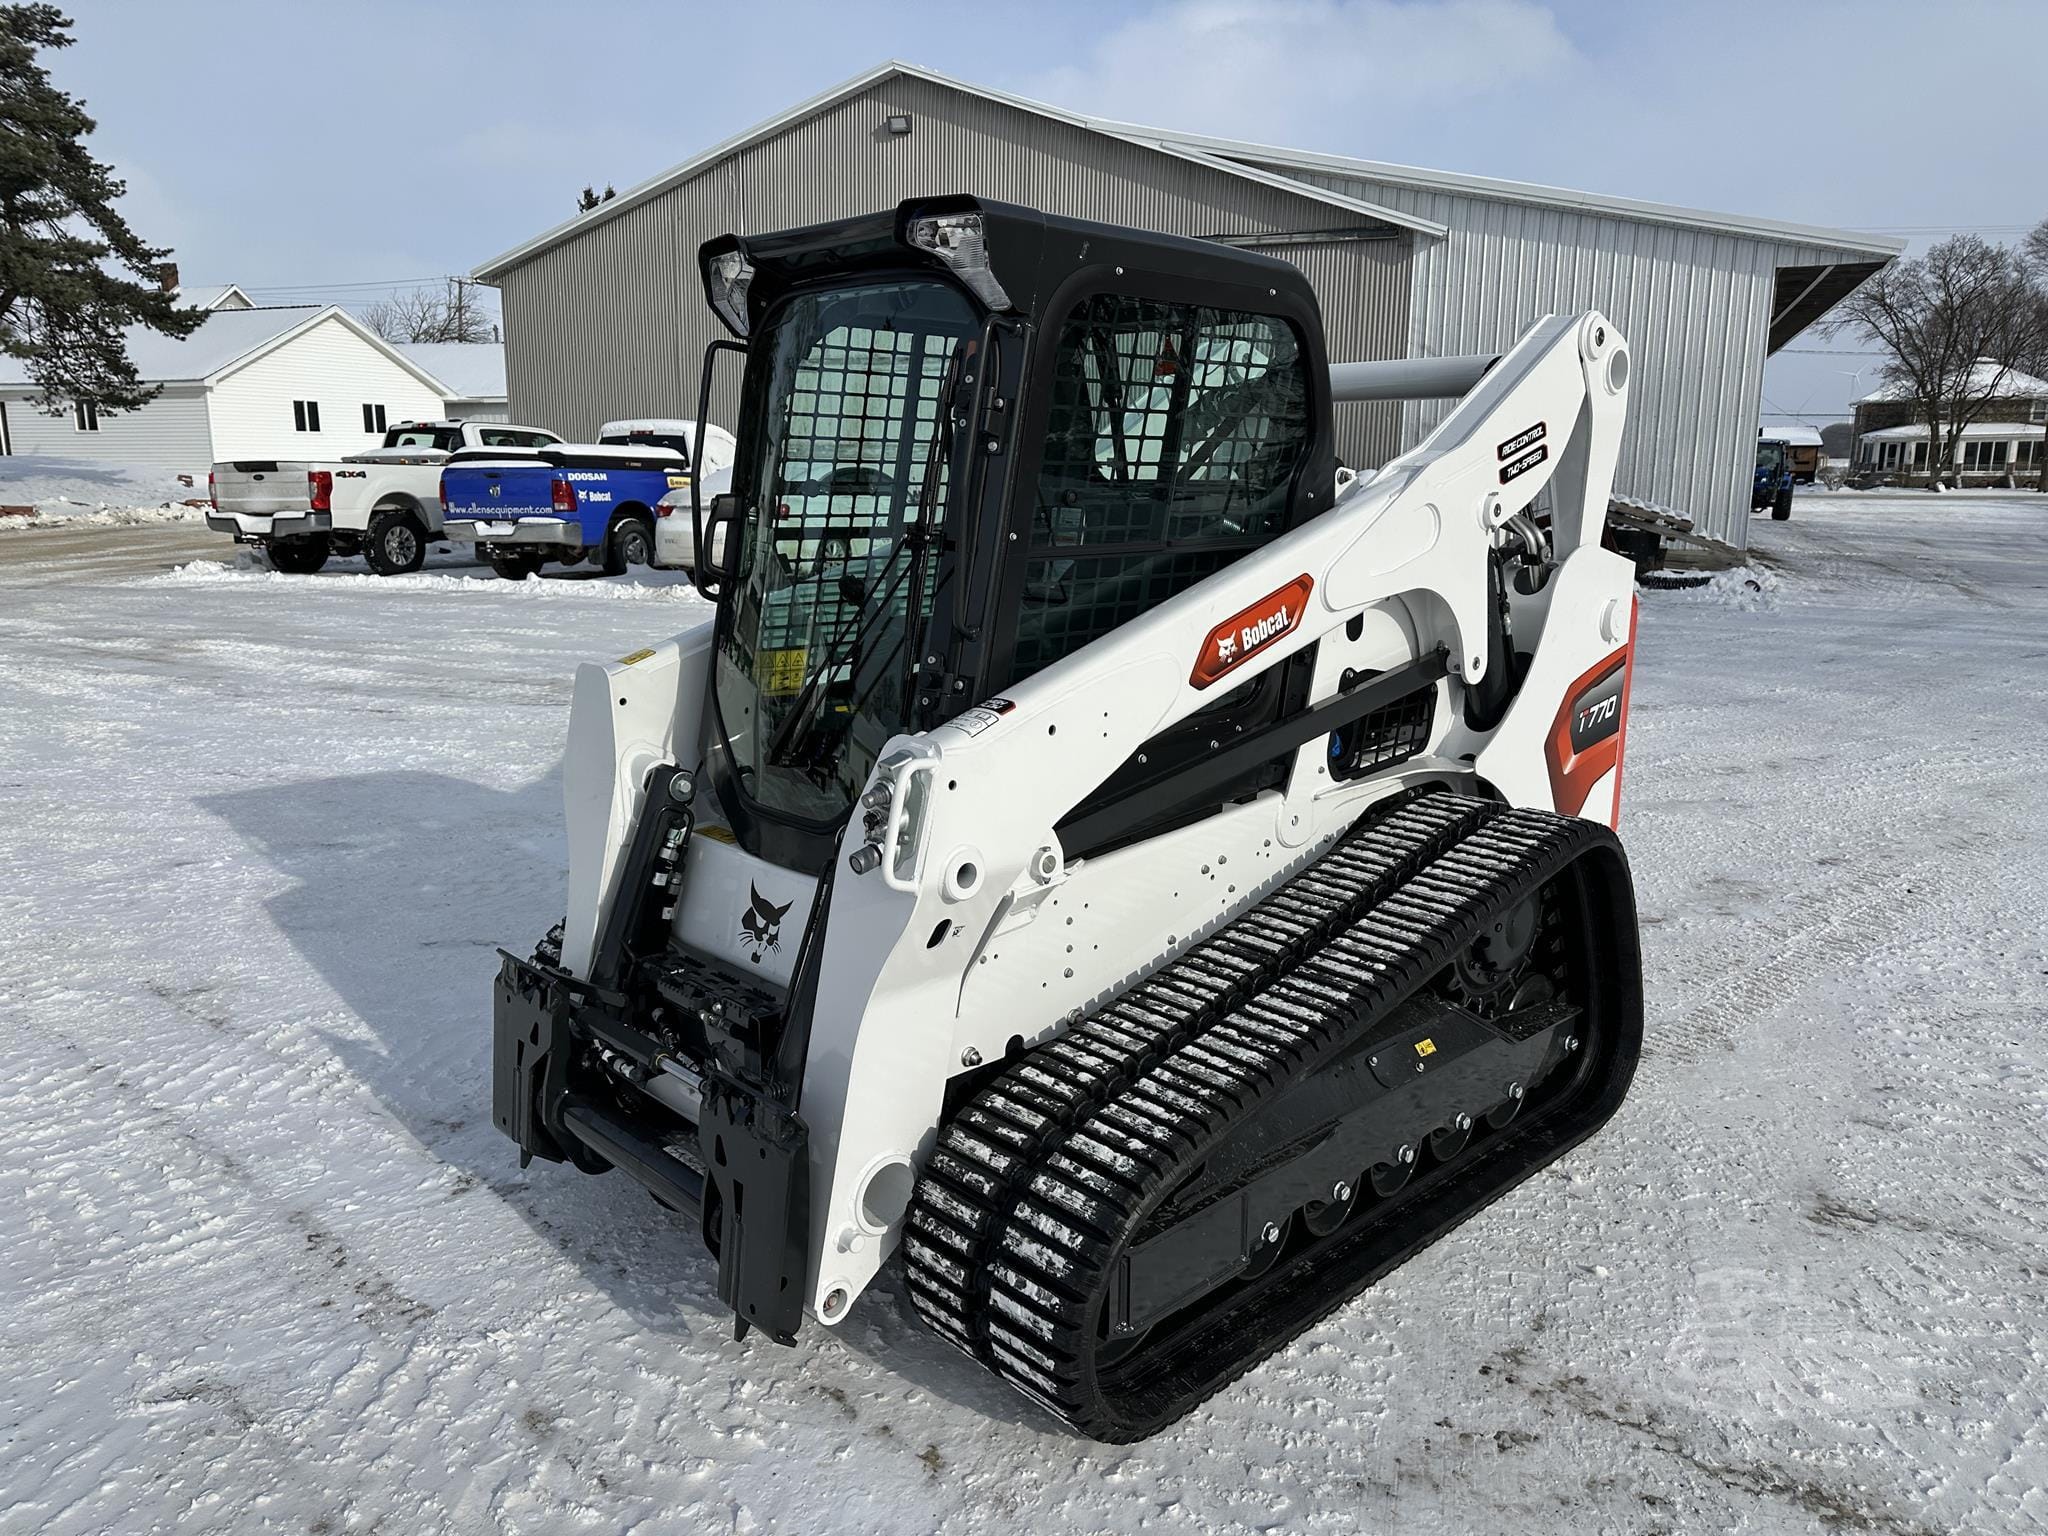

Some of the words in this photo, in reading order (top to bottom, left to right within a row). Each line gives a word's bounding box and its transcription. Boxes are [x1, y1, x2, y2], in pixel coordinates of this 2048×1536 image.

[1516, 425, 1544, 449] CONTROL
[567, 472, 608, 481] DOOSAN
[1507, 449, 1543, 478] TWO-SPEED
[589, 491, 612, 502] Bobcat
[1241, 604, 1289, 652] Bobcat
[1579, 694, 1618, 733] T770
